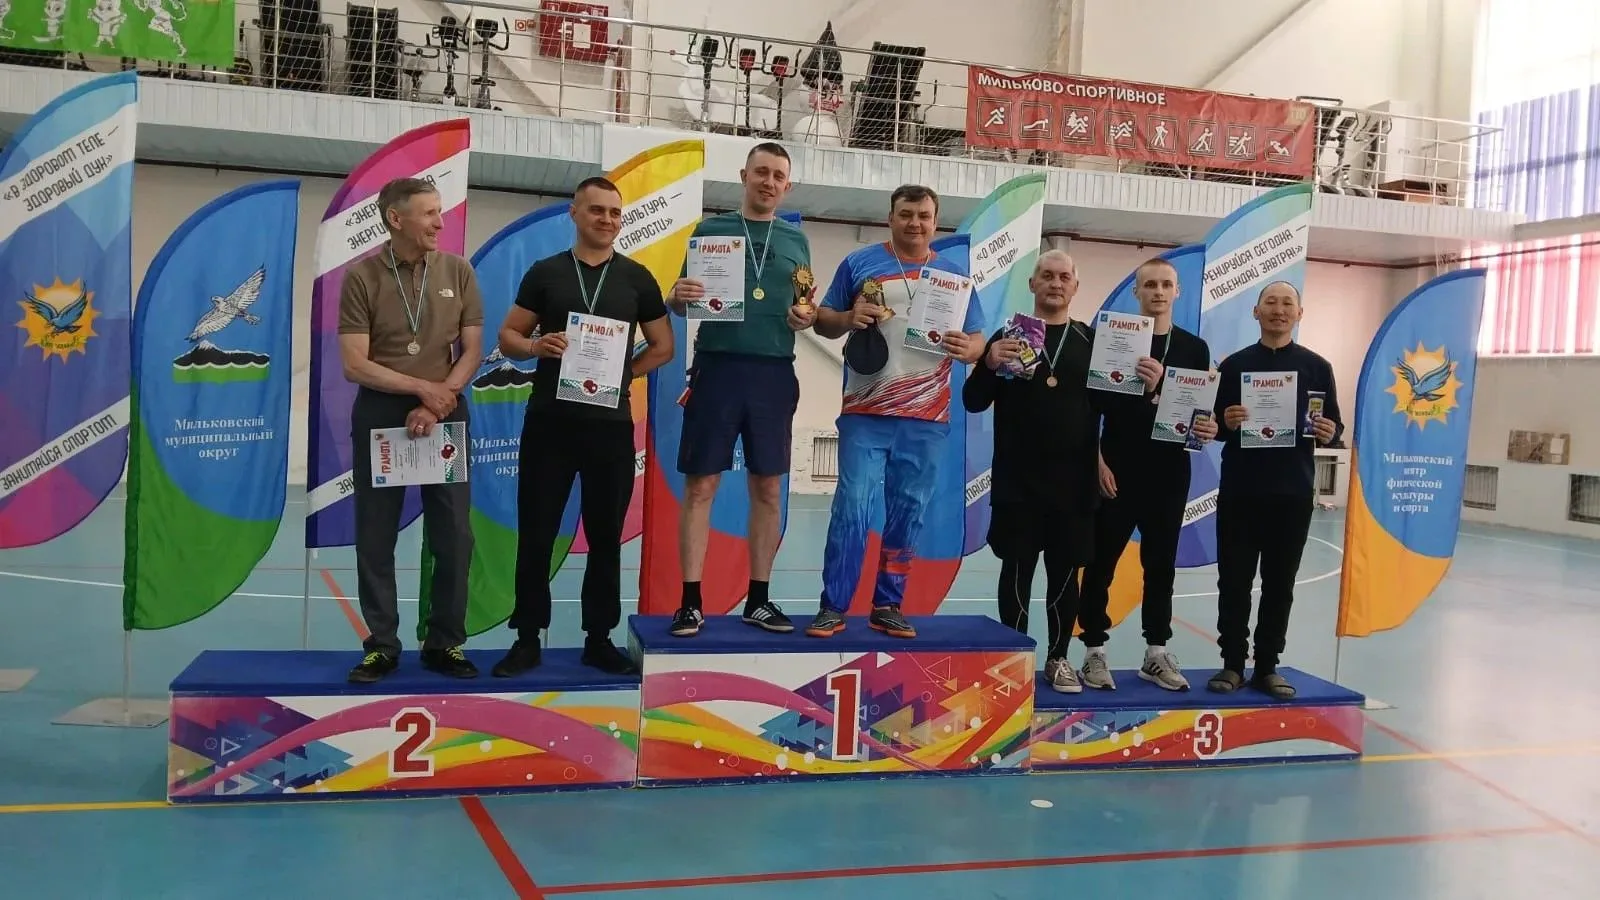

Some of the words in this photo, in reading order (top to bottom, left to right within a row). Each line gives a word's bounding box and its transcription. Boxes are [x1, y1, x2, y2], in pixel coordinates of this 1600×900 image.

[978, 72, 1064, 95] МИЛЬКОВО
[1066, 83, 1166, 106] СПОРТИВНОЕ
[20, 147, 77, 191] ЗДОРОВОМ
[76, 132, 106, 155] ТЕЛЕ
[23, 167, 83, 212] ЗДОРОВЫЙ
[619, 196, 668, 229] КУЛЬТУРА
[347, 222, 389, 250] ЭНЕРГИ
[619, 217, 673, 250] СТАРОСТИ»
[1203, 250, 1254, 285] РЕНИРУЙСЯ
[1253, 228, 1294, 258] СЕГОДНЯ
[929, 276, 960, 292] ГРАМОТА
[972, 269, 986, 286] ТЫ
[1209, 264, 1260, 300] ПОБЕЖДАЙ
[1108, 319, 1140, 331] ГРАМОТА
[1175, 375, 1206, 387] ГРАМОТА
[1252, 379, 1284, 388] ГРАМОТА
[165, 428, 273, 448] муниципальный
[174, 415, 264, 431] Мильковский
[1, 444, 62, 490] ЗАНИМАЙСЯ
[62, 413, 117, 453] СПОРТОМ
[198, 447, 239, 460] округ
[380, 440, 392, 474] ГРАМОТА
[470, 451, 519, 467] уницип
[495, 465, 519, 478] окр
[826, 669, 862, 761] 1
[388, 706, 436, 777] 2
[1193, 710, 1223, 759] 3
